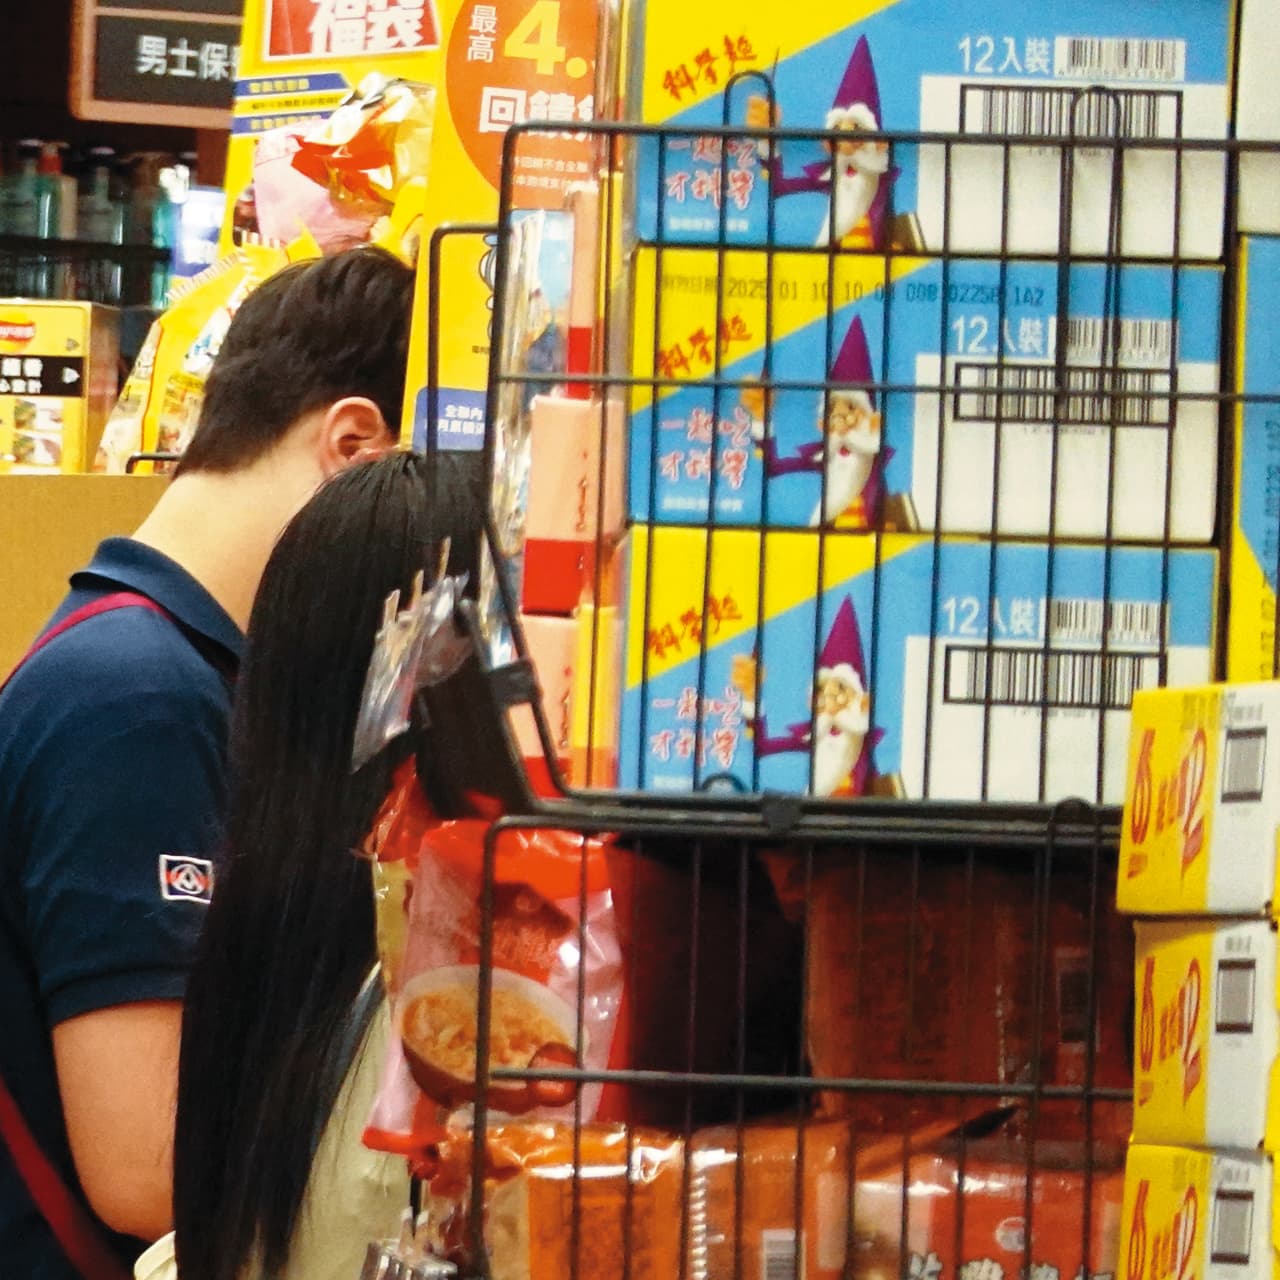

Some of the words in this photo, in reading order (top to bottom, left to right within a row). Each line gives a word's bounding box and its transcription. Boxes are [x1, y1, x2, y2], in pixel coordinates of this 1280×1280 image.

[135, 33, 240, 81] 男士保
[466, 4, 498, 63] 最高
[957, 34, 1051, 75] 12入裝
